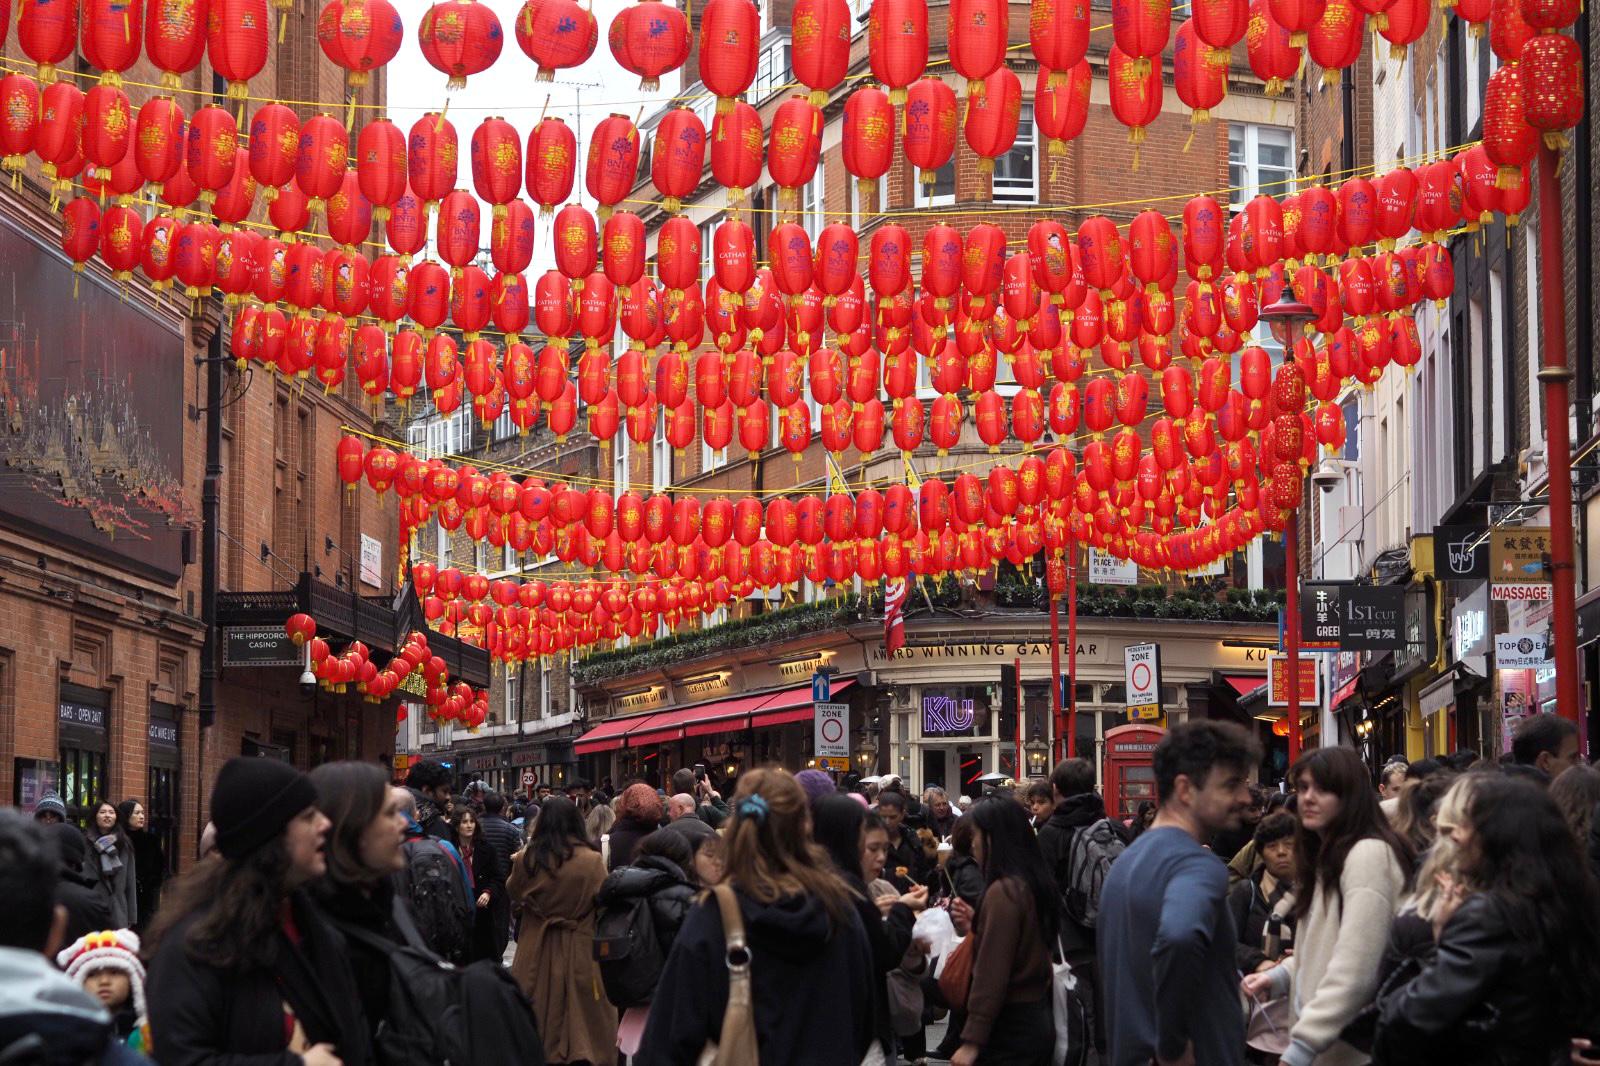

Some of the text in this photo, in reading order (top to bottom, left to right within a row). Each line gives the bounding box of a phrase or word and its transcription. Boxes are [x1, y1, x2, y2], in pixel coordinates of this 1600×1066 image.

[1381, 198, 1407, 207] CATHAY
[719, 251, 746, 259] CATHAY
[1492, 586, 1547, 600] MASSAGE
[922, 644, 1005, 658] WINNING
[1016, 644, 1052, 655] GAY
[1498, 642, 1517, 650] TOP
[1131, 652, 1150, 662] ZONE
[1246, 649, 1266, 661] KU
[60, 704, 73, 719] BARS
[78, 708, 91, 721] OPEN
[822, 710, 843, 718] ZONE
[923, 696, 974, 732] KU
